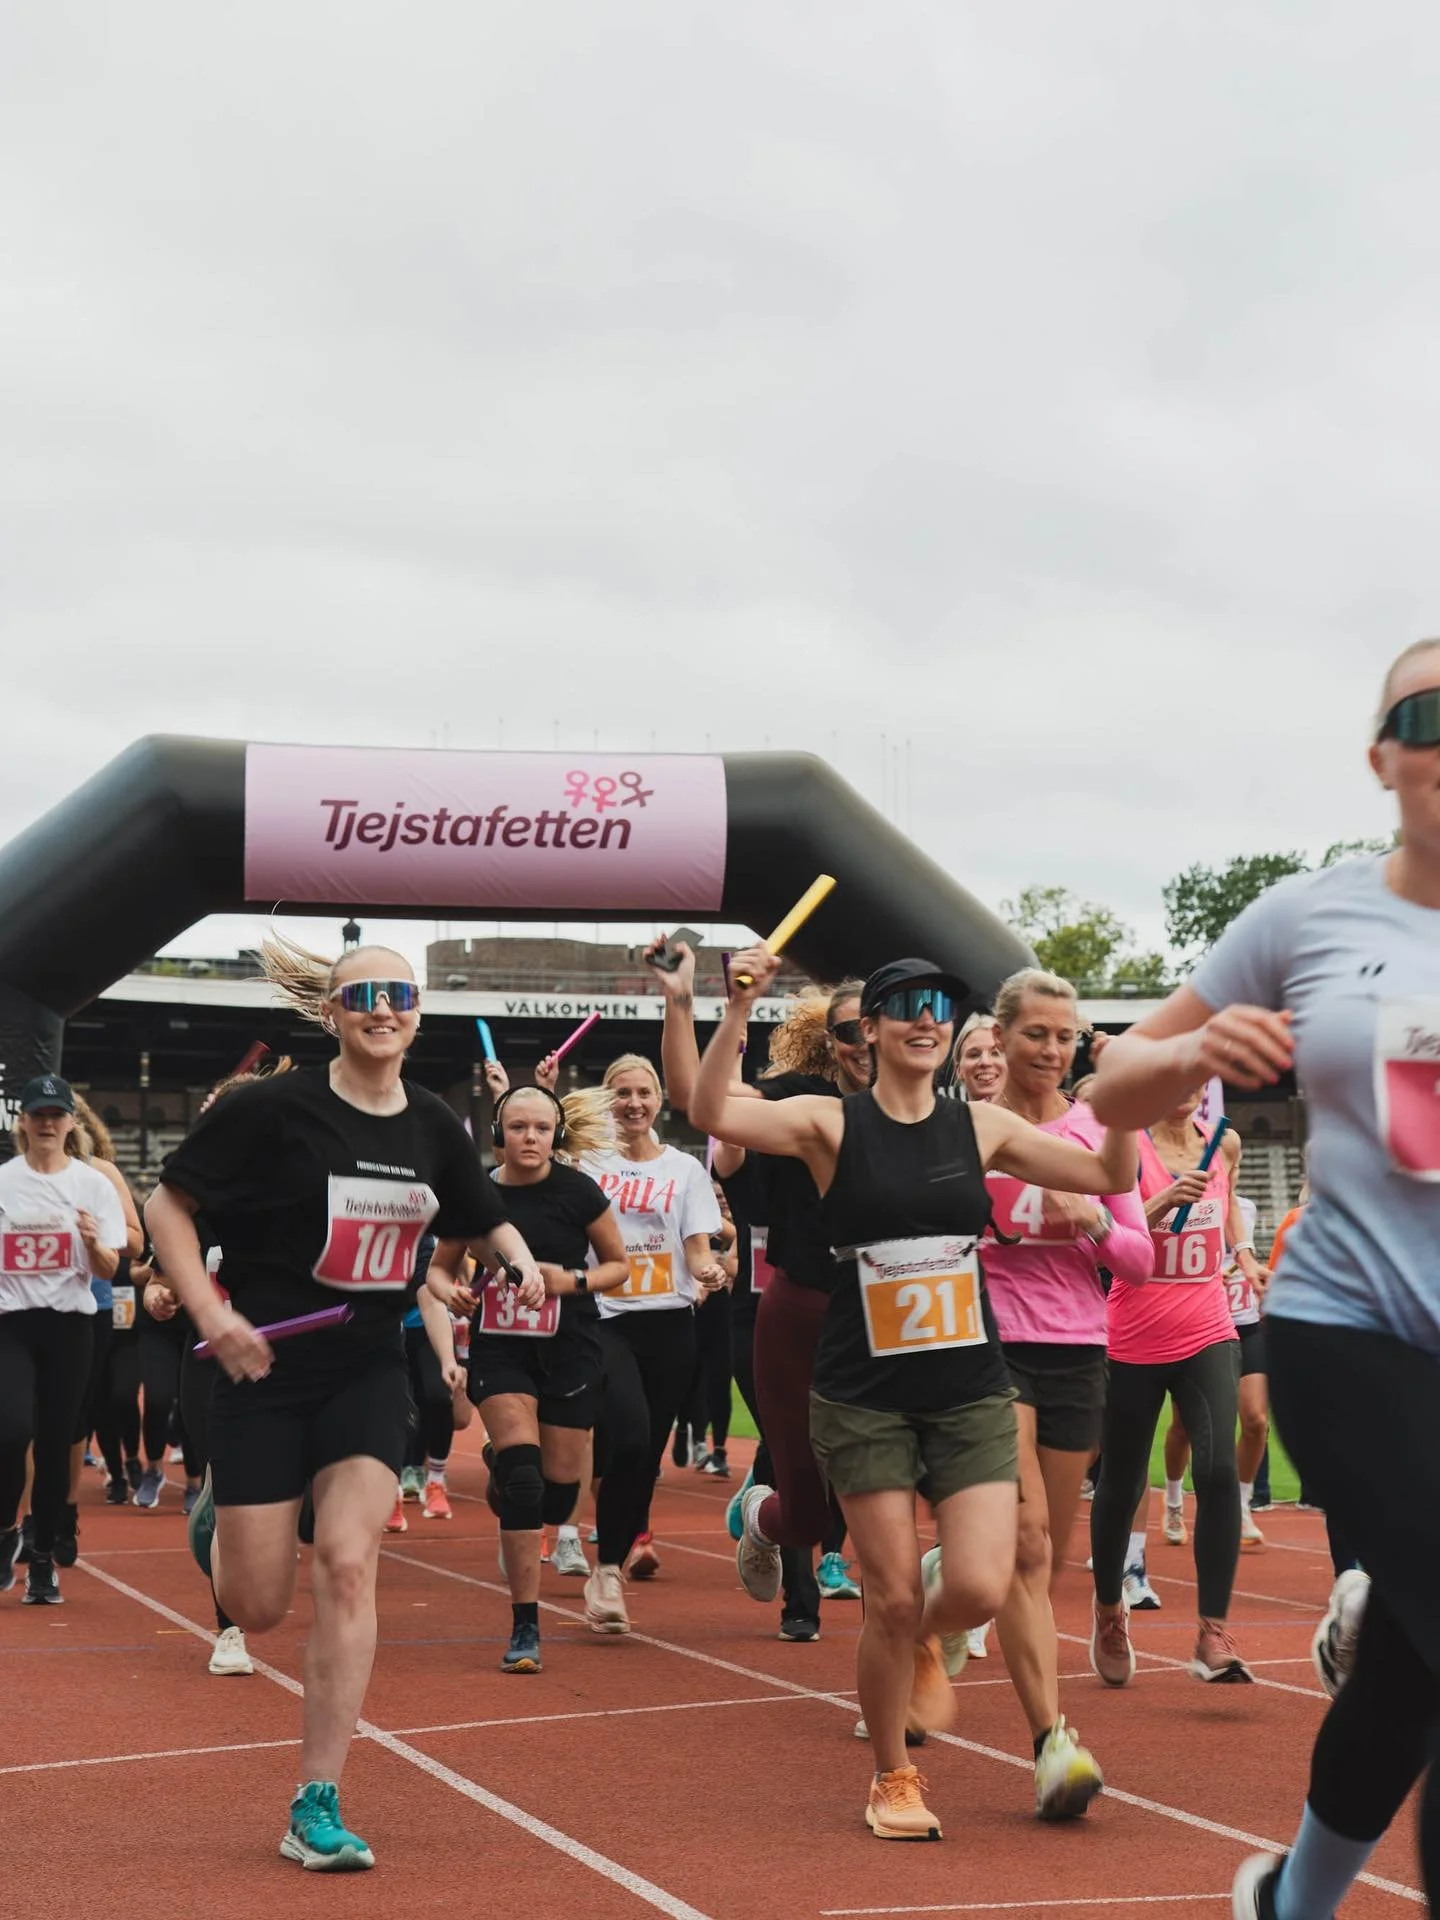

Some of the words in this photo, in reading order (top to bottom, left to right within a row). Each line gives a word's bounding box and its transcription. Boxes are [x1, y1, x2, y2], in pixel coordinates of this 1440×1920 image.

[320, 799, 632, 852] Tjejstafetten
[599, 1173, 676, 1215] PALLA
[1010, 1184, 1045, 1234] 4
[15, 1236, 60, 1269] 32
[352, 1223, 400, 1281] 10
[1163, 1234, 1207, 1276] 16
[496, 1289, 541, 1329] 34
[895, 1280, 958, 1340] 21
